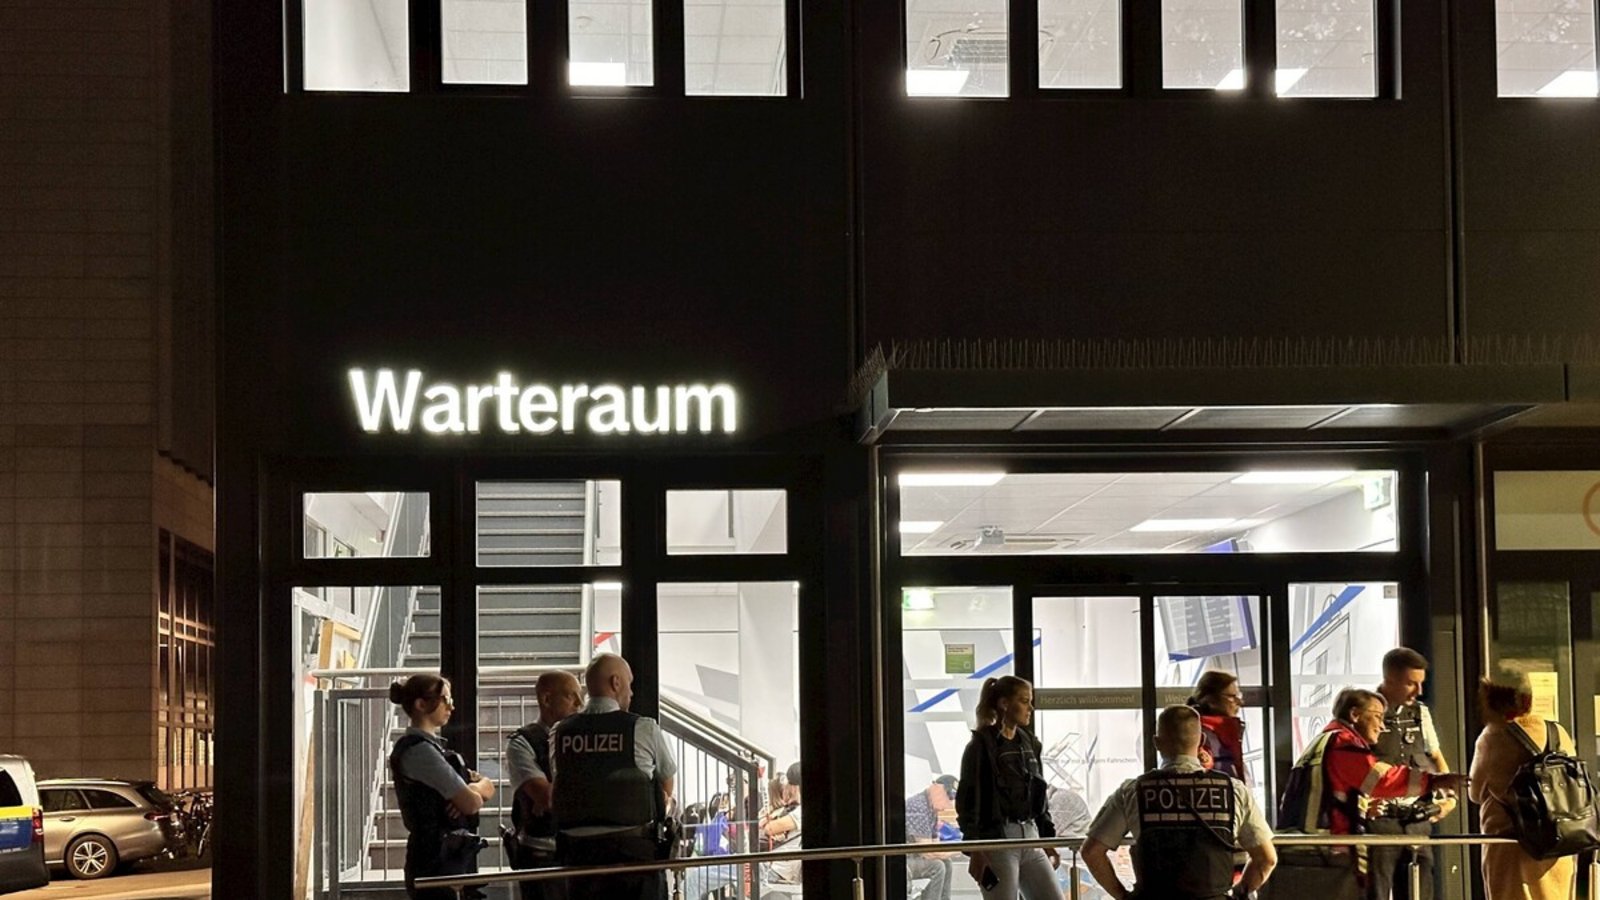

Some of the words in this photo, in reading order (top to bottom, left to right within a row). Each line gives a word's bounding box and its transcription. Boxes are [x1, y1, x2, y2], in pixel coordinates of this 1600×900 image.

[348, 369, 738, 434] Warteraum
[1040, 696, 1076, 705] Herzlich
[562, 733, 624, 753] POLIZEI
[1143, 787, 1229, 810] POLIZEI
